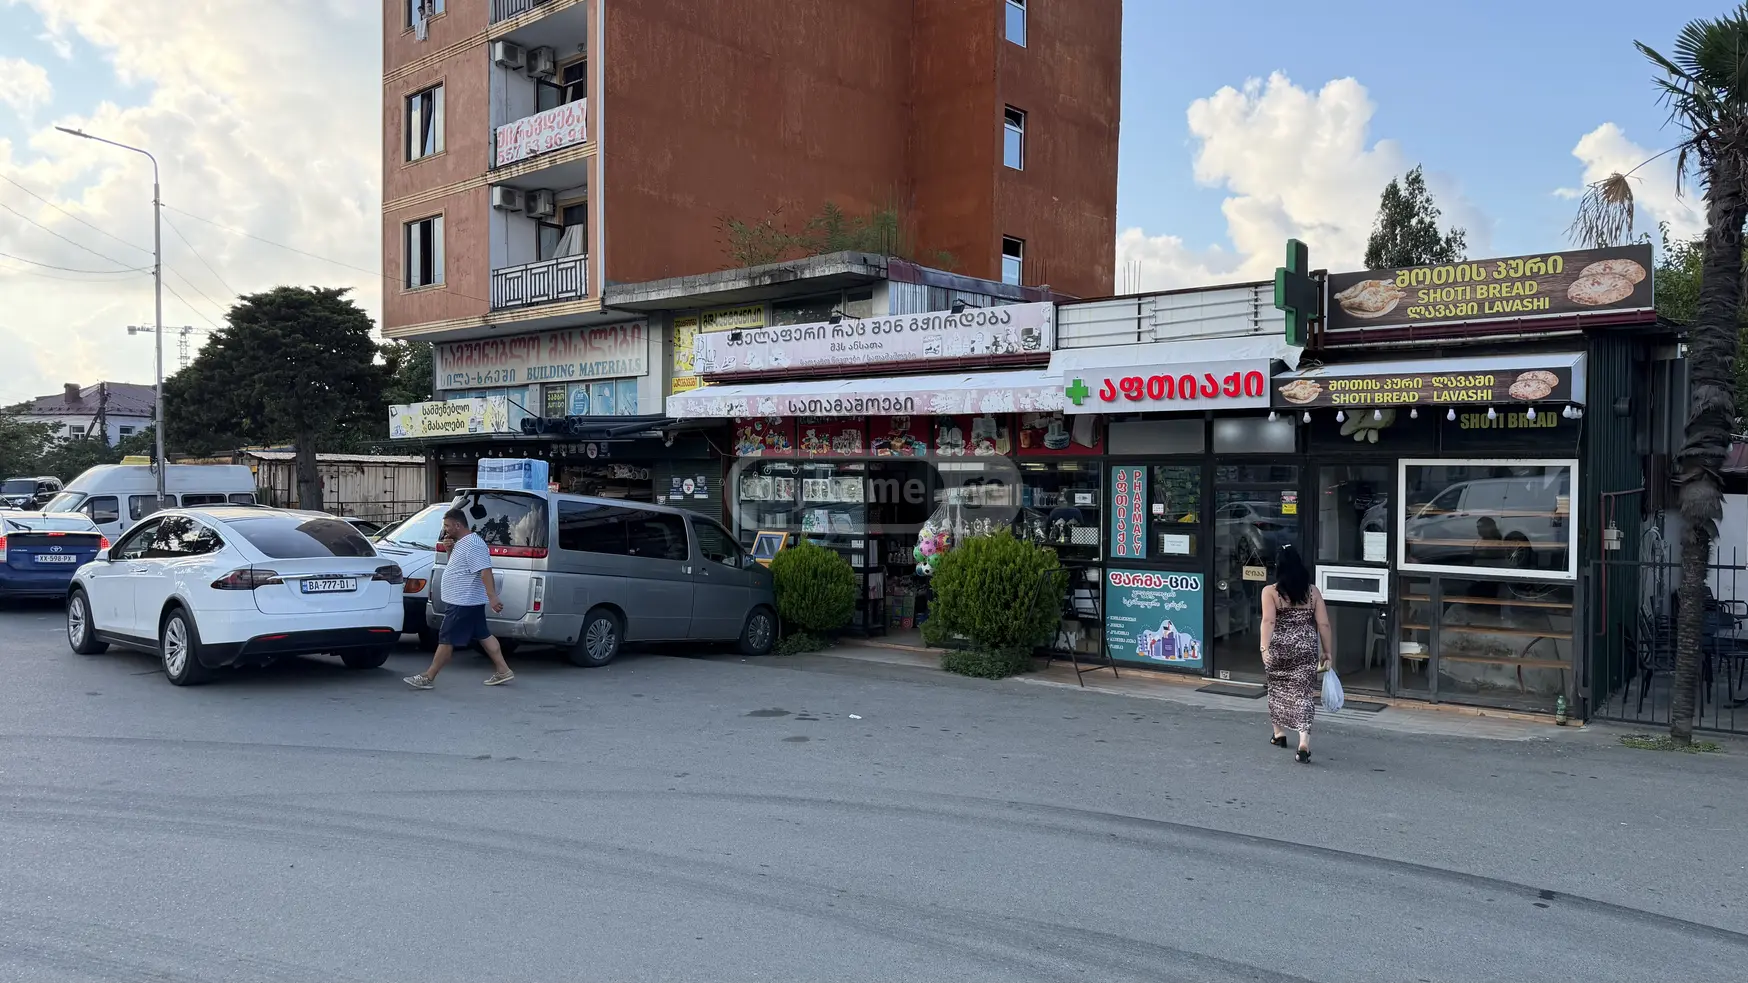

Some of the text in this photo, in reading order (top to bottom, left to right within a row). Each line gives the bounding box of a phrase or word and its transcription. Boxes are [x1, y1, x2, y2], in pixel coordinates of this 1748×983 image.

[497, 102, 585, 148] ქირავდება
[497, 145, 521, 163] 557
[545, 132, 562, 149] 96
[1395, 255, 1564, 288] შოთის პური
[1417, 281, 1538, 304] SHOTI BREAD
[1407, 297, 1550, 319] ლავაში LAVASHI
[831, 322, 866, 338] რაც
[871, 319, 904, 335] შენ
[909, 310, 1011, 331] გჭირდება
[440, 324, 642, 371] სამშენებლო მასალები
[526, 363, 575, 380] BUILDING
[579, 358, 642, 377] MATERIALS
[1099, 369, 1265, 402] აფთიაქი
[1328, 375, 1495, 391] შოთის პური ლავაში
[788, 396, 914, 413] სათამაშოები
[1332, 389, 1492, 404] SHOTI BREAD LAVASHI
[422, 403, 470, 417] სამშენებლო
[427, 420, 465, 432] მასალები
[1115, 469, 1129, 556] აფთიაქი
[1132, 470, 1143, 556] PHARMACY
[1109, 571, 1201, 591] ფარმა-ცია
